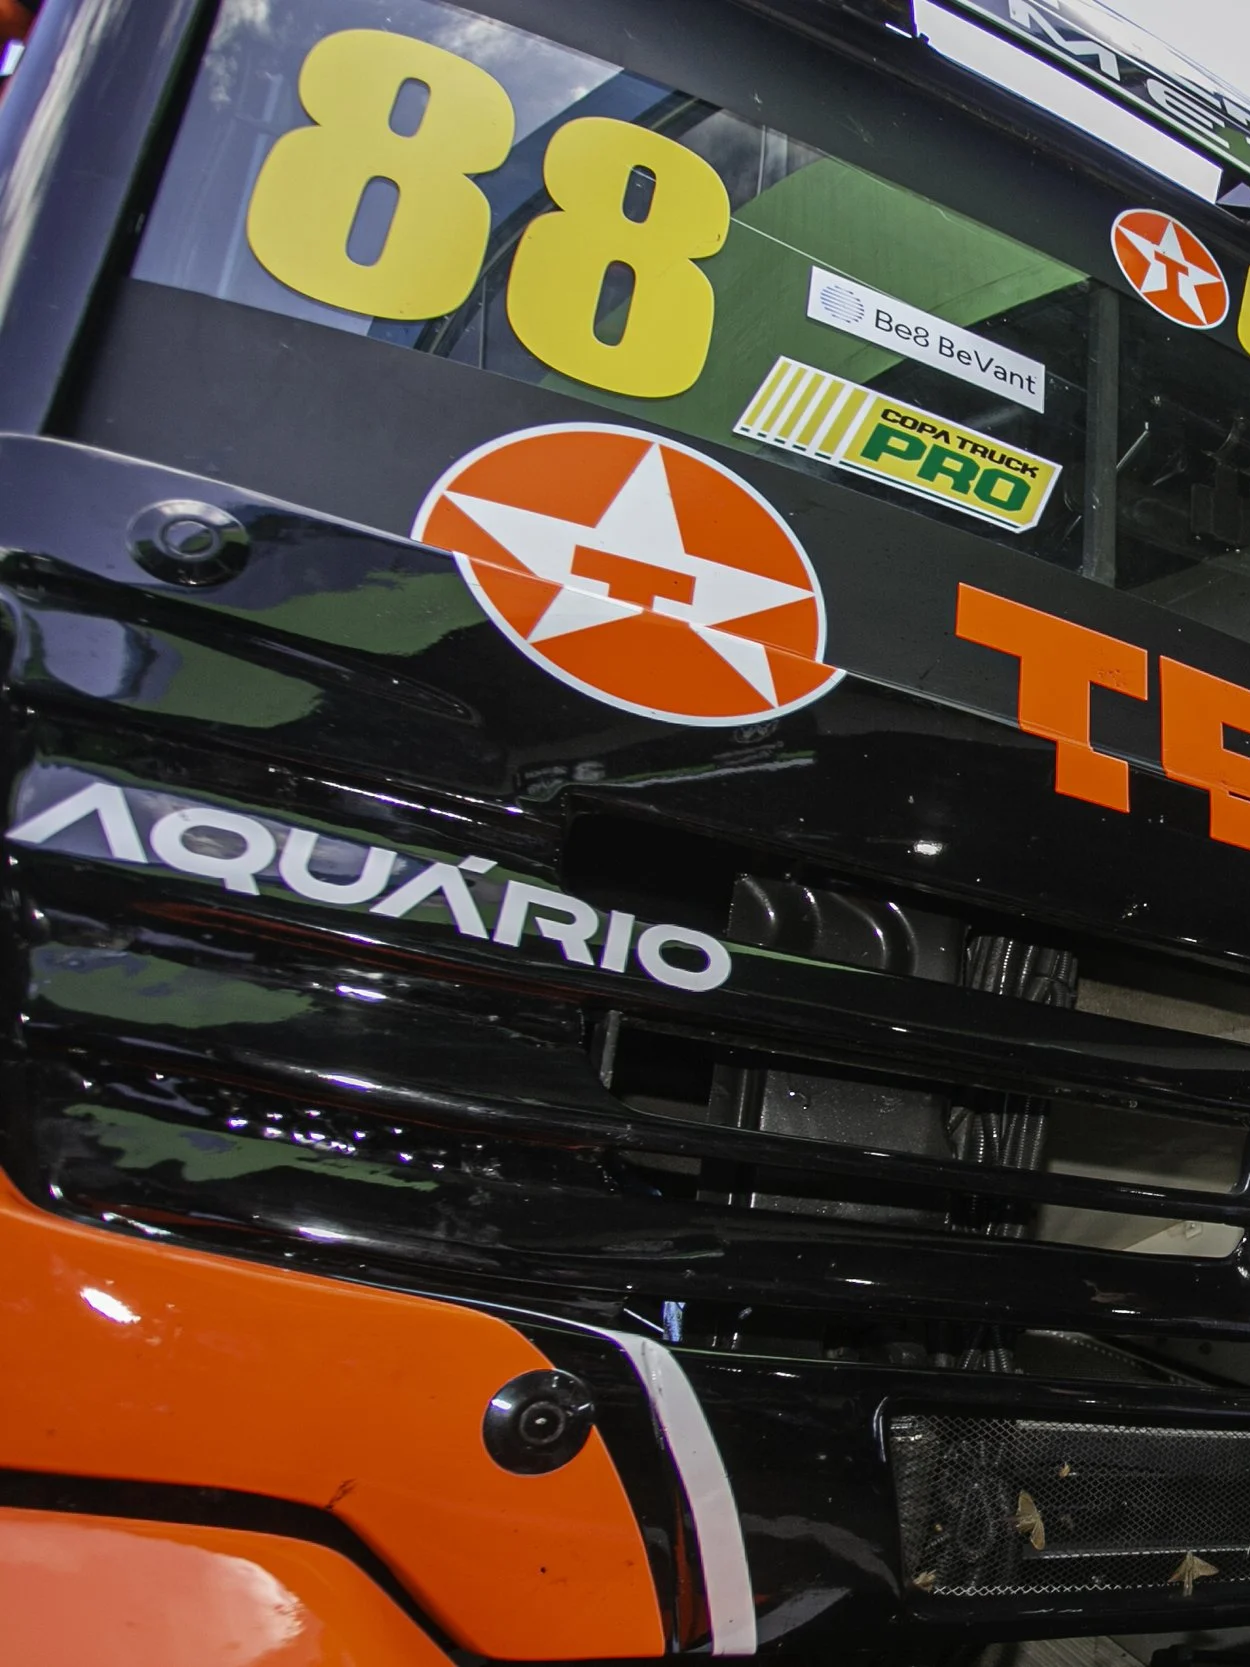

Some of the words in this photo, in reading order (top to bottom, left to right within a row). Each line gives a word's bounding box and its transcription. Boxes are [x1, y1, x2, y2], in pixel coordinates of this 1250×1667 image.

[247, 28, 731, 399] 88
[874, 309, 930, 348] Be8
[939, 335, 1036, 395] BeVant
[860, 422, 1031, 512] PRO
[880, 408, 951, 445] COPA
[956, 435, 1039, 479] TRUCK
[6, 782, 732, 993] AQUÁRIO
